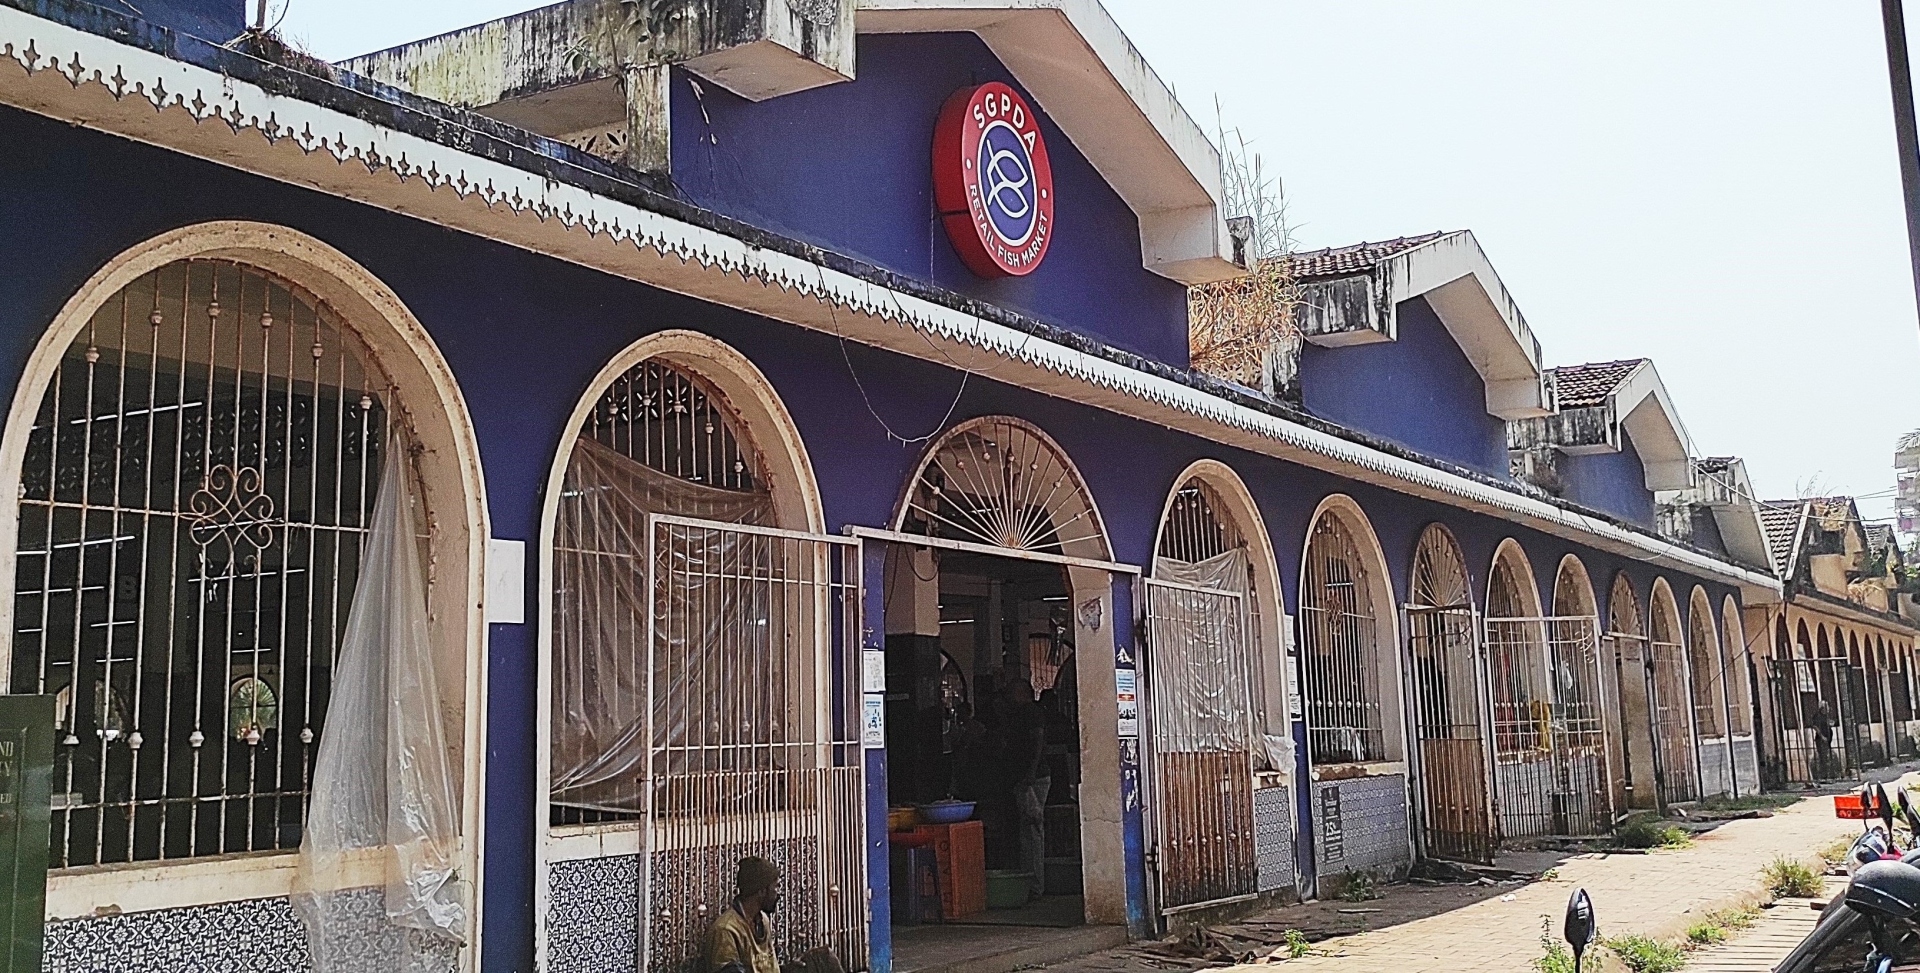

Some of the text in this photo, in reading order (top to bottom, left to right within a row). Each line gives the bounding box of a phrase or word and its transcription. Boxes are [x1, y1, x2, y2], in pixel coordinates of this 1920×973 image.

[974, 93, 1036, 154] SGPDA
[970, 184, 1048, 268] RETAIL FISH MARKET
